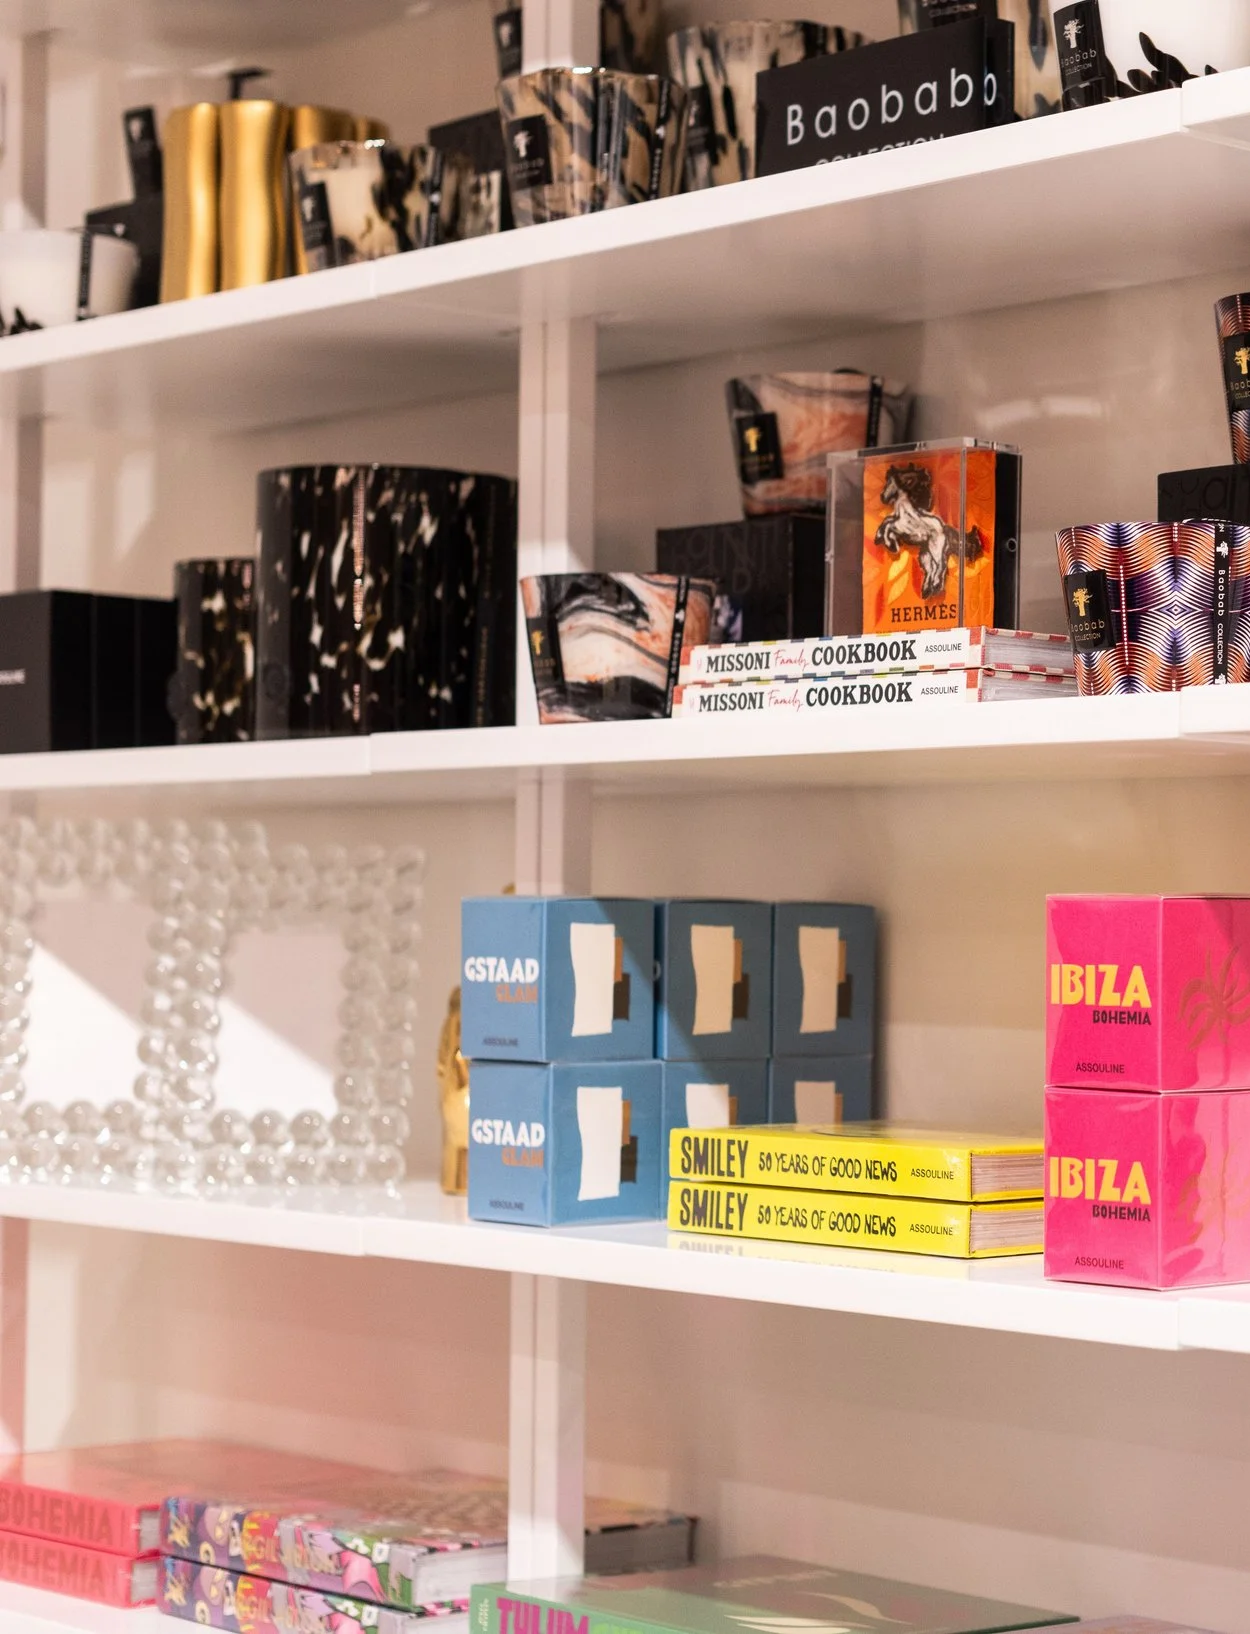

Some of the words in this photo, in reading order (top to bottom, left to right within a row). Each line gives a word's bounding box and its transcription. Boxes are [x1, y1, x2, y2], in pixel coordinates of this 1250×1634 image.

[786, 67, 974, 146] Baobab
[1218, 569, 1226, 616] Baobab
[706, 651, 771, 673] MISSONI
[773, 648, 809, 672] Family
[811, 640, 917, 667] COOKBOOK
[924, 643, 962, 653] ASSOULINE
[699, 692, 764, 713] MISSONI
[768, 689, 803, 713] Family
[806, 682, 914, 707] COOKBOOK
[920, 685, 959, 696] ASSOULINE
[464, 956, 540, 984] GSTAAD
[1050, 964, 1152, 1009] IBIZA
[1093, 1010, 1152, 1025] BOHEMIA
[1076, 1062, 1125, 1074] ASSOULINE
[471, 1118, 545, 1147] GSTAAD
[681, 1135, 749, 1178] SMILEY
[758, 1152, 772, 1171] 50
[774, 1152, 809, 1175] YEARS
[812, 1155, 827, 1176] OF
[830, 1157, 862, 1179] GOOD
[865, 1160, 898, 1182] NEWS
[910, 1168, 954, 1180] ASSOULINE
[1049, 1156, 1152, 1205] IBIZA
[680, 1188, 749, 1231] SMILEY
[757, 1204, 771, 1224] 50
[773, 1206, 808, 1228] YEARS
[811, 1209, 827, 1230] OF
[829, 1212, 861, 1233] GOOD
[864, 1215, 897, 1237] NEWS
[909, 1223, 953, 1236] ASSOULINE
[1092, 1205, 1151, 1222] BOHEMIA
[1075, 1256, 1124, 1270] ASSOULINE
